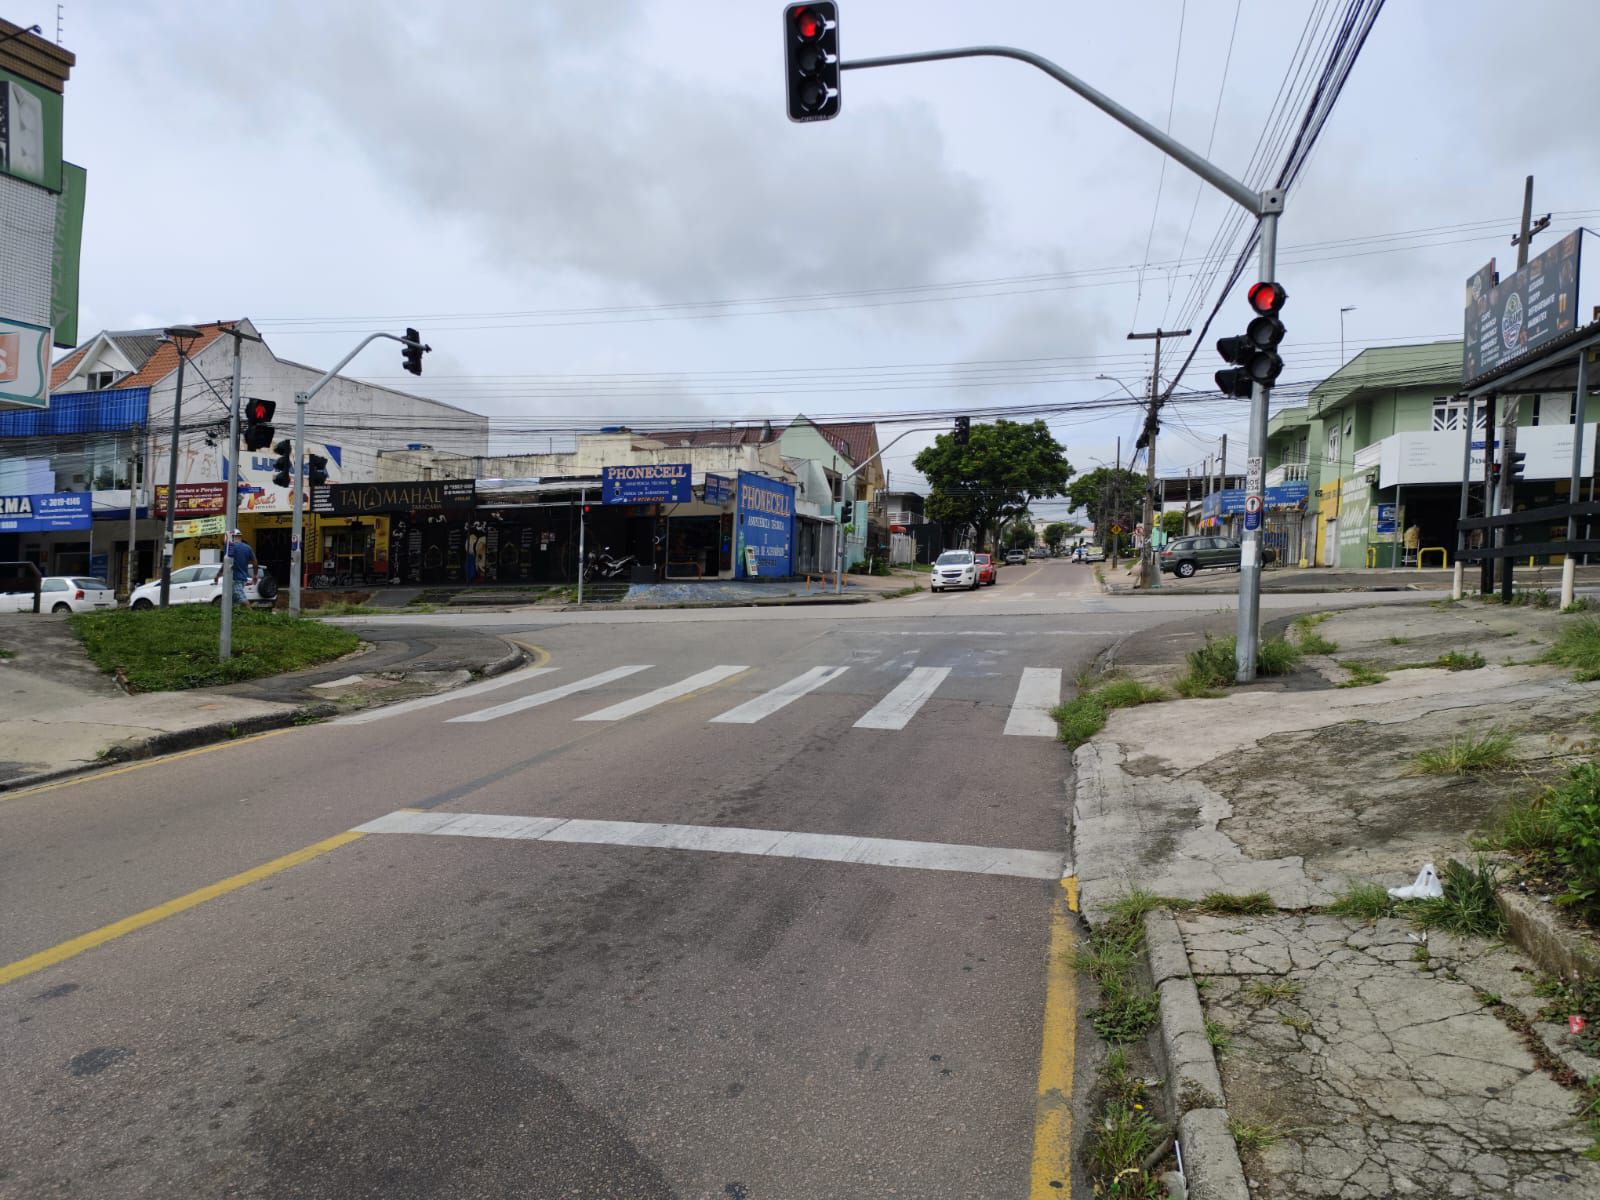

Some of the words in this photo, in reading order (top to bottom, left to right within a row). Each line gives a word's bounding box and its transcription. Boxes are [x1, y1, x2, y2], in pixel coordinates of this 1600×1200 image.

[607, 466, 687, 480] PHONECELL
[341, 490, 363, 509] TAJ
[383, 487, 441, 505] MAHAL
[741, 485, 790, 518] PHONECELL
